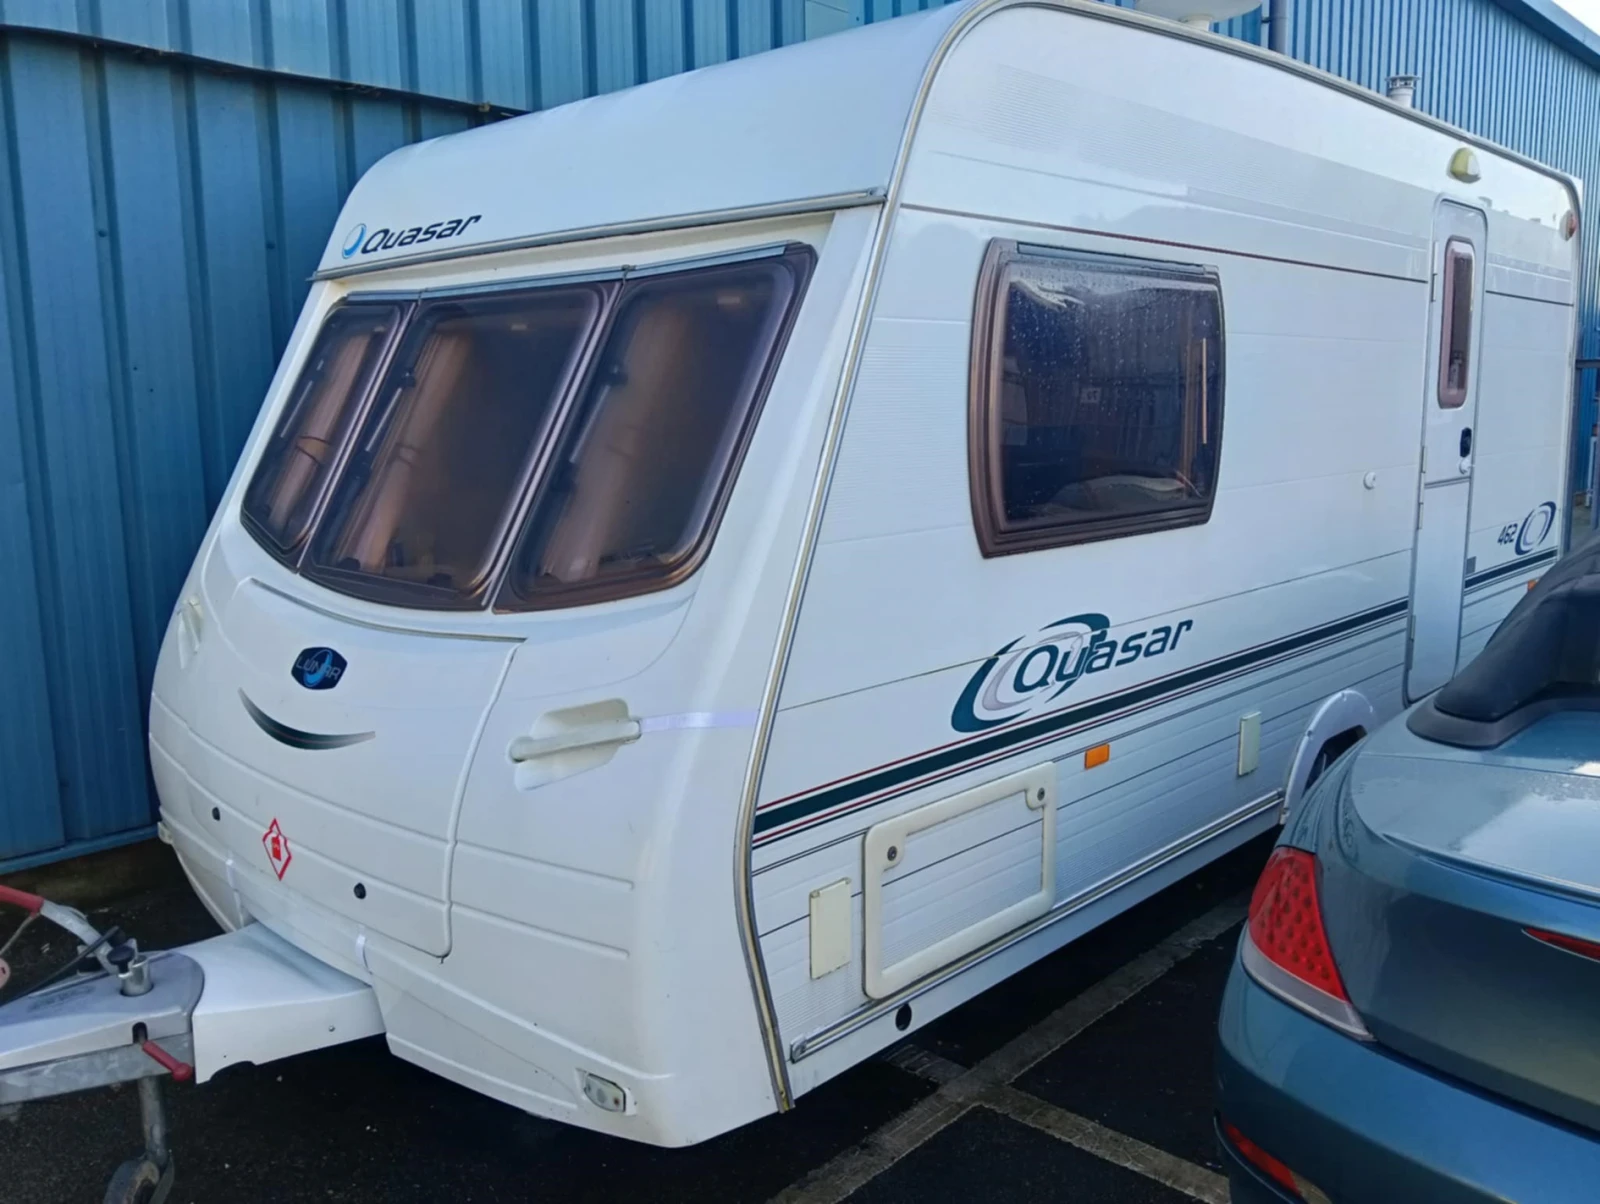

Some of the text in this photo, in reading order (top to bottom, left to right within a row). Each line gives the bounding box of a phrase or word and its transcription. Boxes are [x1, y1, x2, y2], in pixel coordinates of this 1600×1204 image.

[361, 214, 482, 254] Quasar
[1498, 522, 1518, 545] 462
[295, 656, 342, 680] LUNAR
[1013, 619, 1193, 693] Quasar
